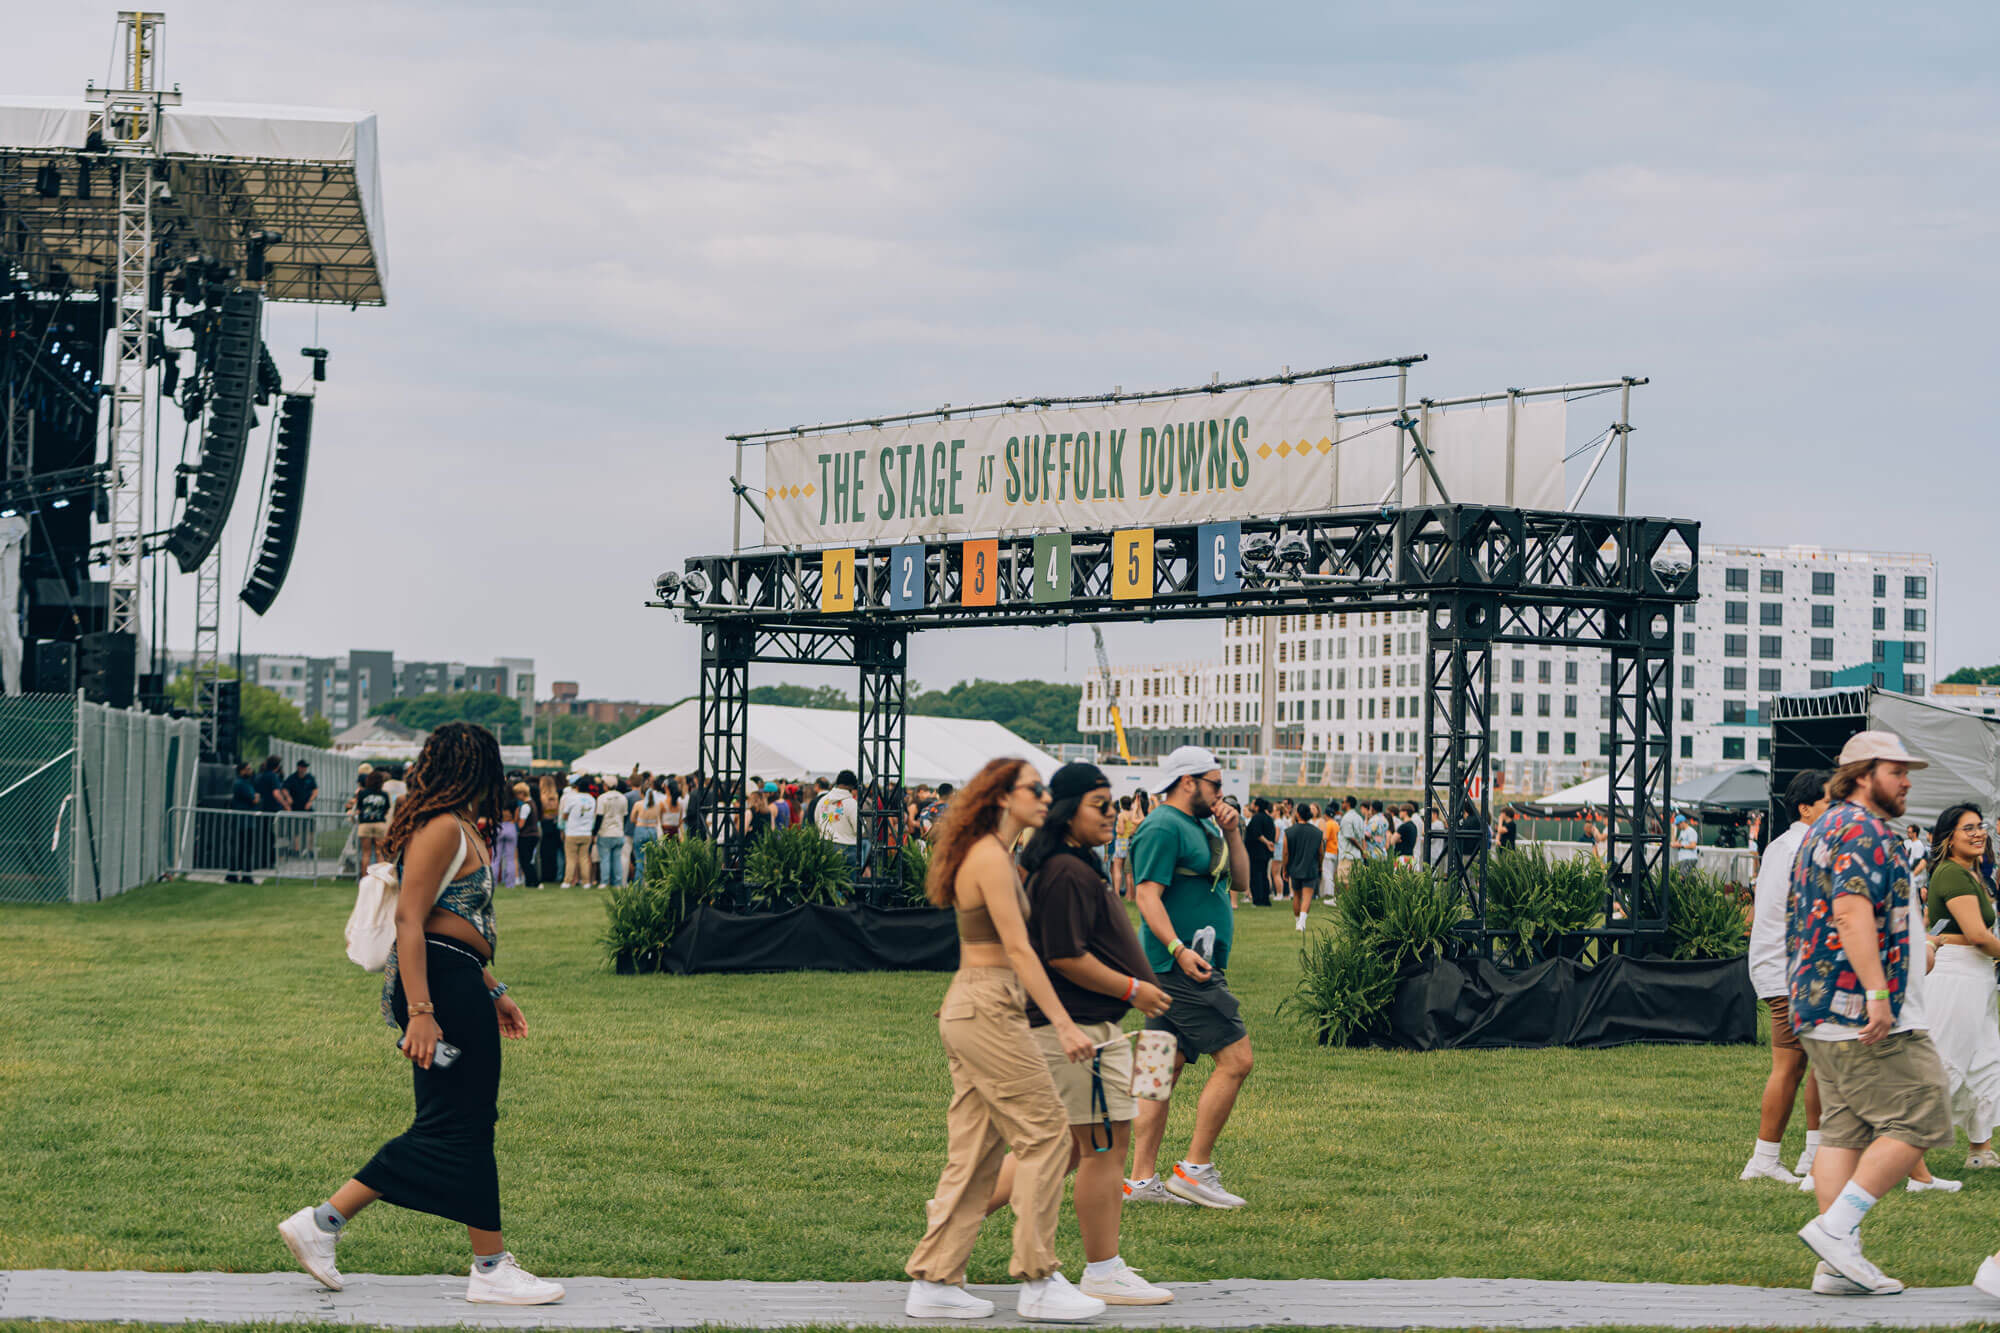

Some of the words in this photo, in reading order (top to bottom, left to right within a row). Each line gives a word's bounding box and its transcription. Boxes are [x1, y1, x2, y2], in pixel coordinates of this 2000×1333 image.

[818, 450, 866, 526] THE
[877, 439, 966, 521] STAGE
[975, 454, 996, 496] AT
[1003, 428, 1127, 506] SUFFOLK
[1139, 415, 1250, 501] DOWNS
[833, 560, 844, 600] 1
[902, 556, 913, 601] 2
[974, 551, 985, 595] 3
[1046, 545, 1059, 590] 4
[1128, 541, 1140, 586] 5
[1213, 533, 1226, 584] 6
